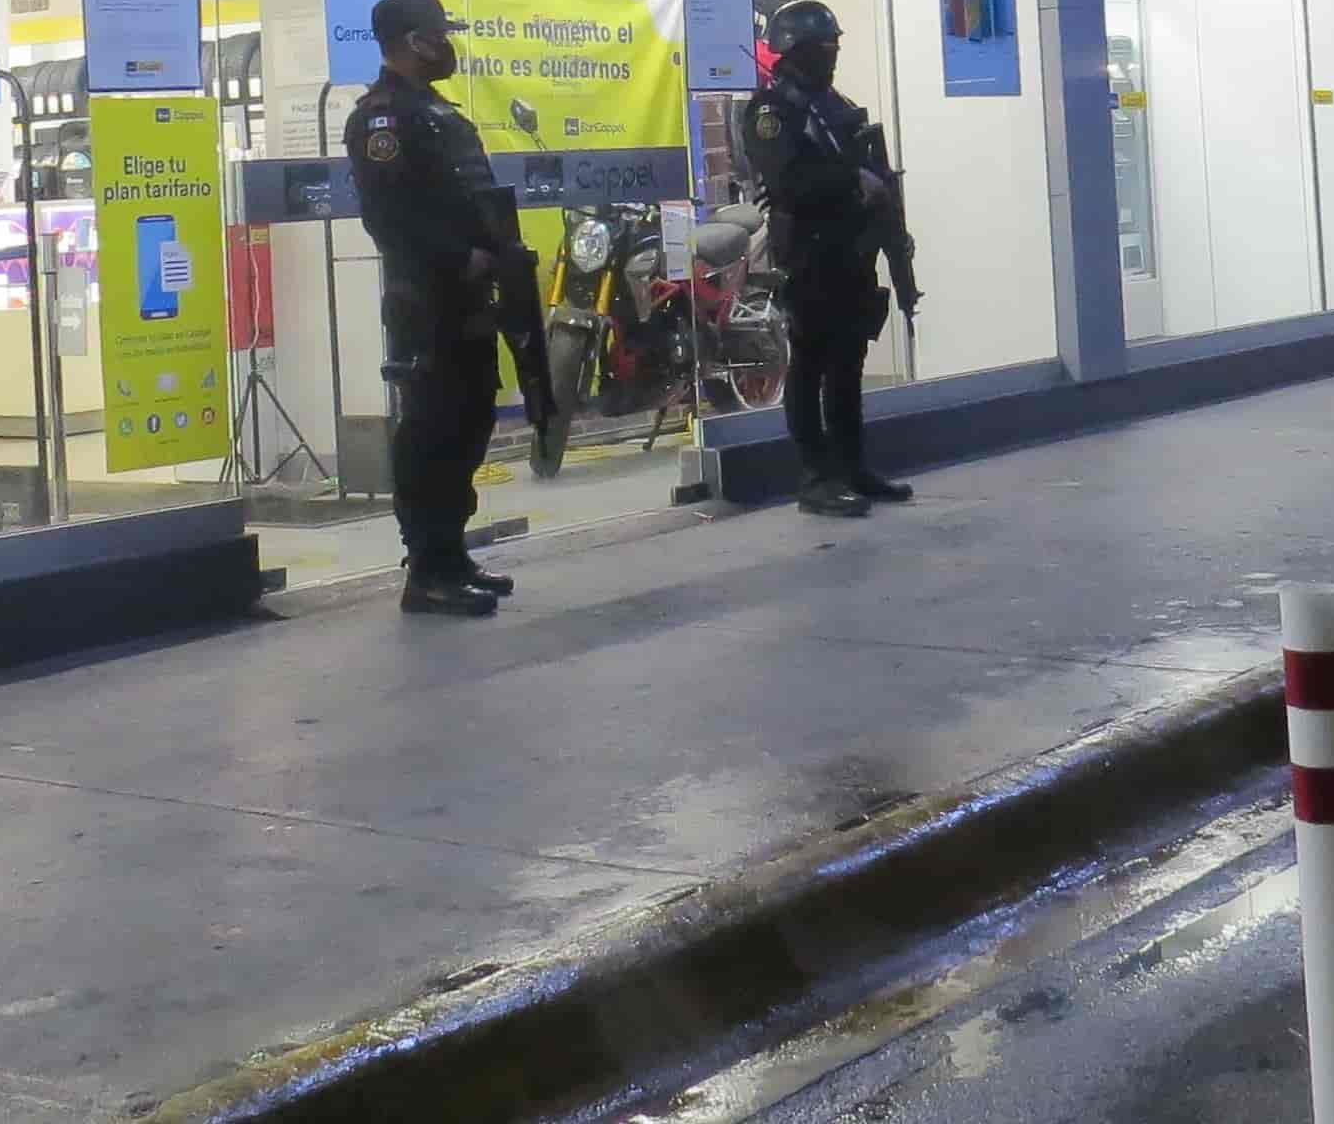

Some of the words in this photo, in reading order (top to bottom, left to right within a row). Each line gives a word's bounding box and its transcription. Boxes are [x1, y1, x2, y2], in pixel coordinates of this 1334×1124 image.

[474, 16, 516, 38] este
[523, 19, 612, 43] momento
[618, 22, 633, 44] el
[456, 55, 504, 77] unto
[510, 58, 532, 77] es
[538, 54, 631, 80] cuidarnos
[123, 156, 164, 178] Elige
[169, 156, 187, 173] tu
[575, 160, 654, 197] Coppel
[104, 180, 141, 204] plan
[145, 177, 212, 198] tarifario
